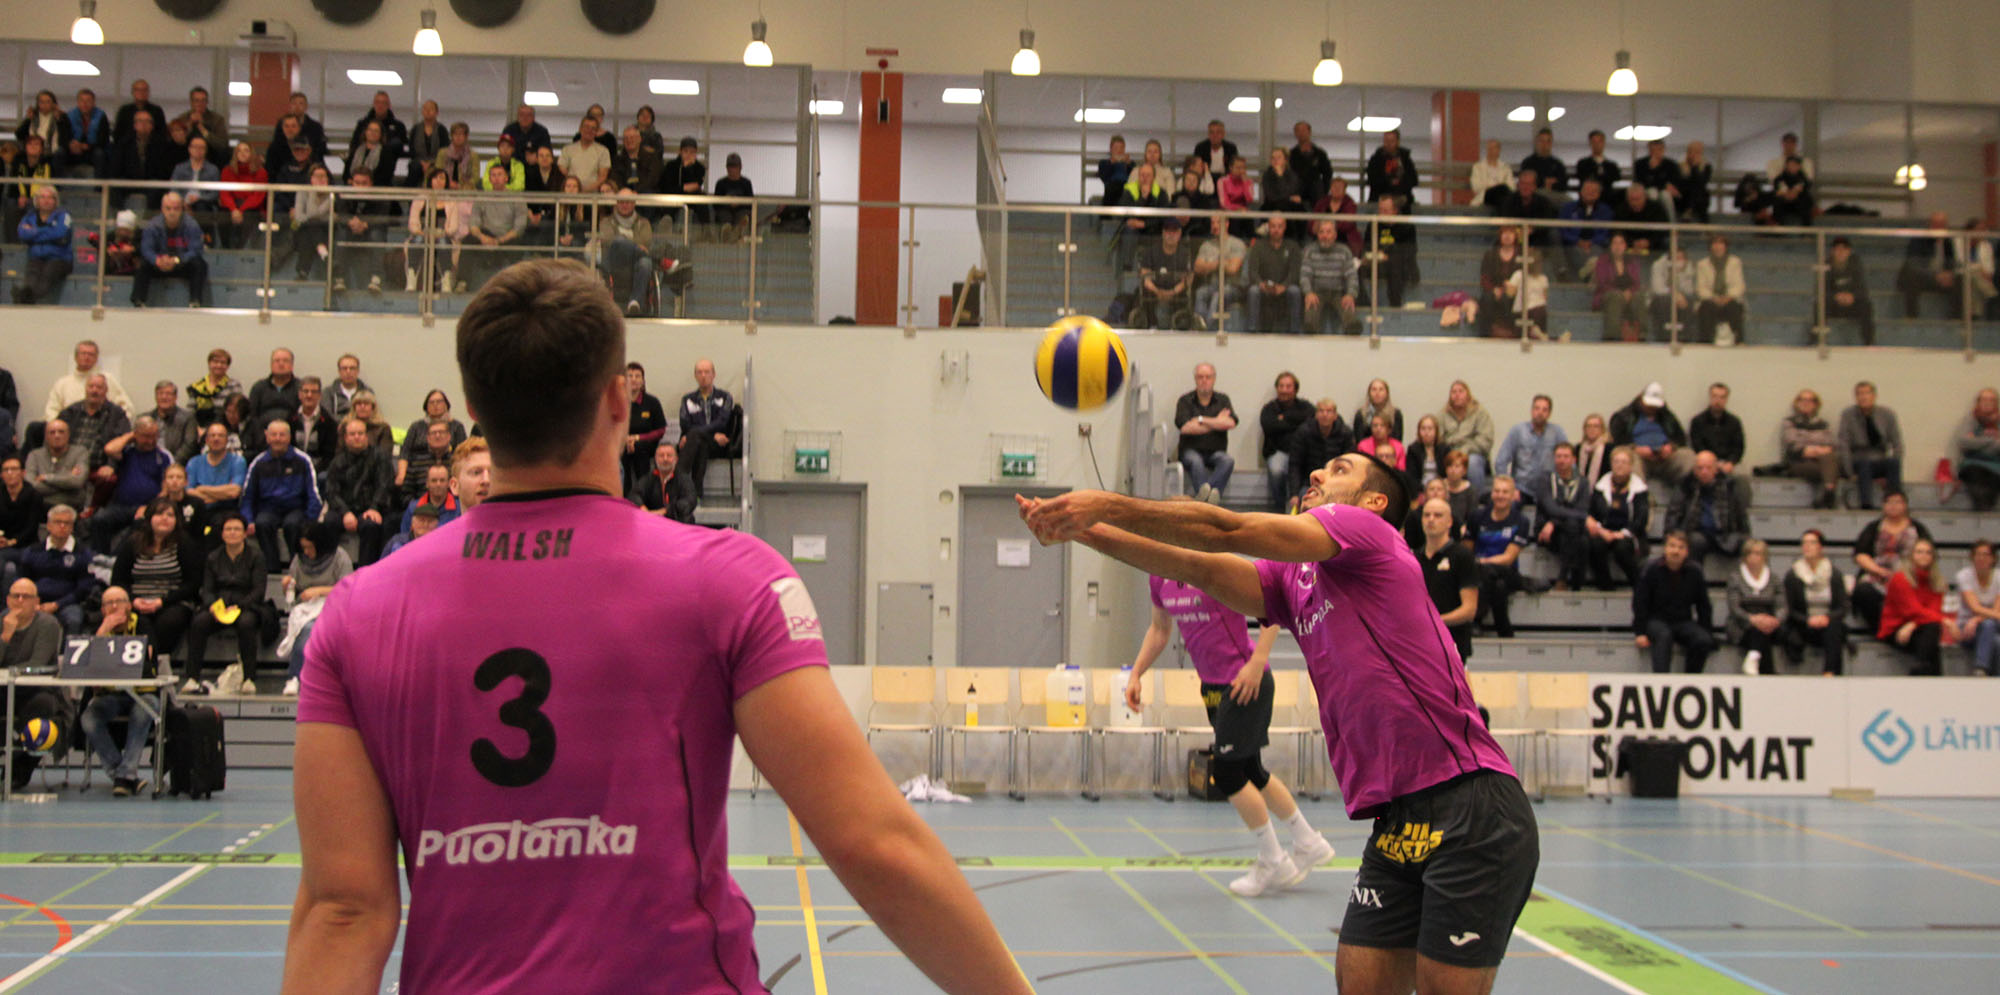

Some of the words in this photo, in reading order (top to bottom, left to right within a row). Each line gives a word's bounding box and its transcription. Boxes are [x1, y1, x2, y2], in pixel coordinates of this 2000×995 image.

[462, 528, 575, 561] WALSH
[68, 640, 89, 665] 7
[107, 640, 115, 655] 1
[122, 640, 144, 665] 8
[470, 647, 557, 788] 3
[1592, 685, 1742, 730] SAVON
[1592, 735, 1814, 782] SOMAT
[416, 815, 638, 868] Puolanka
